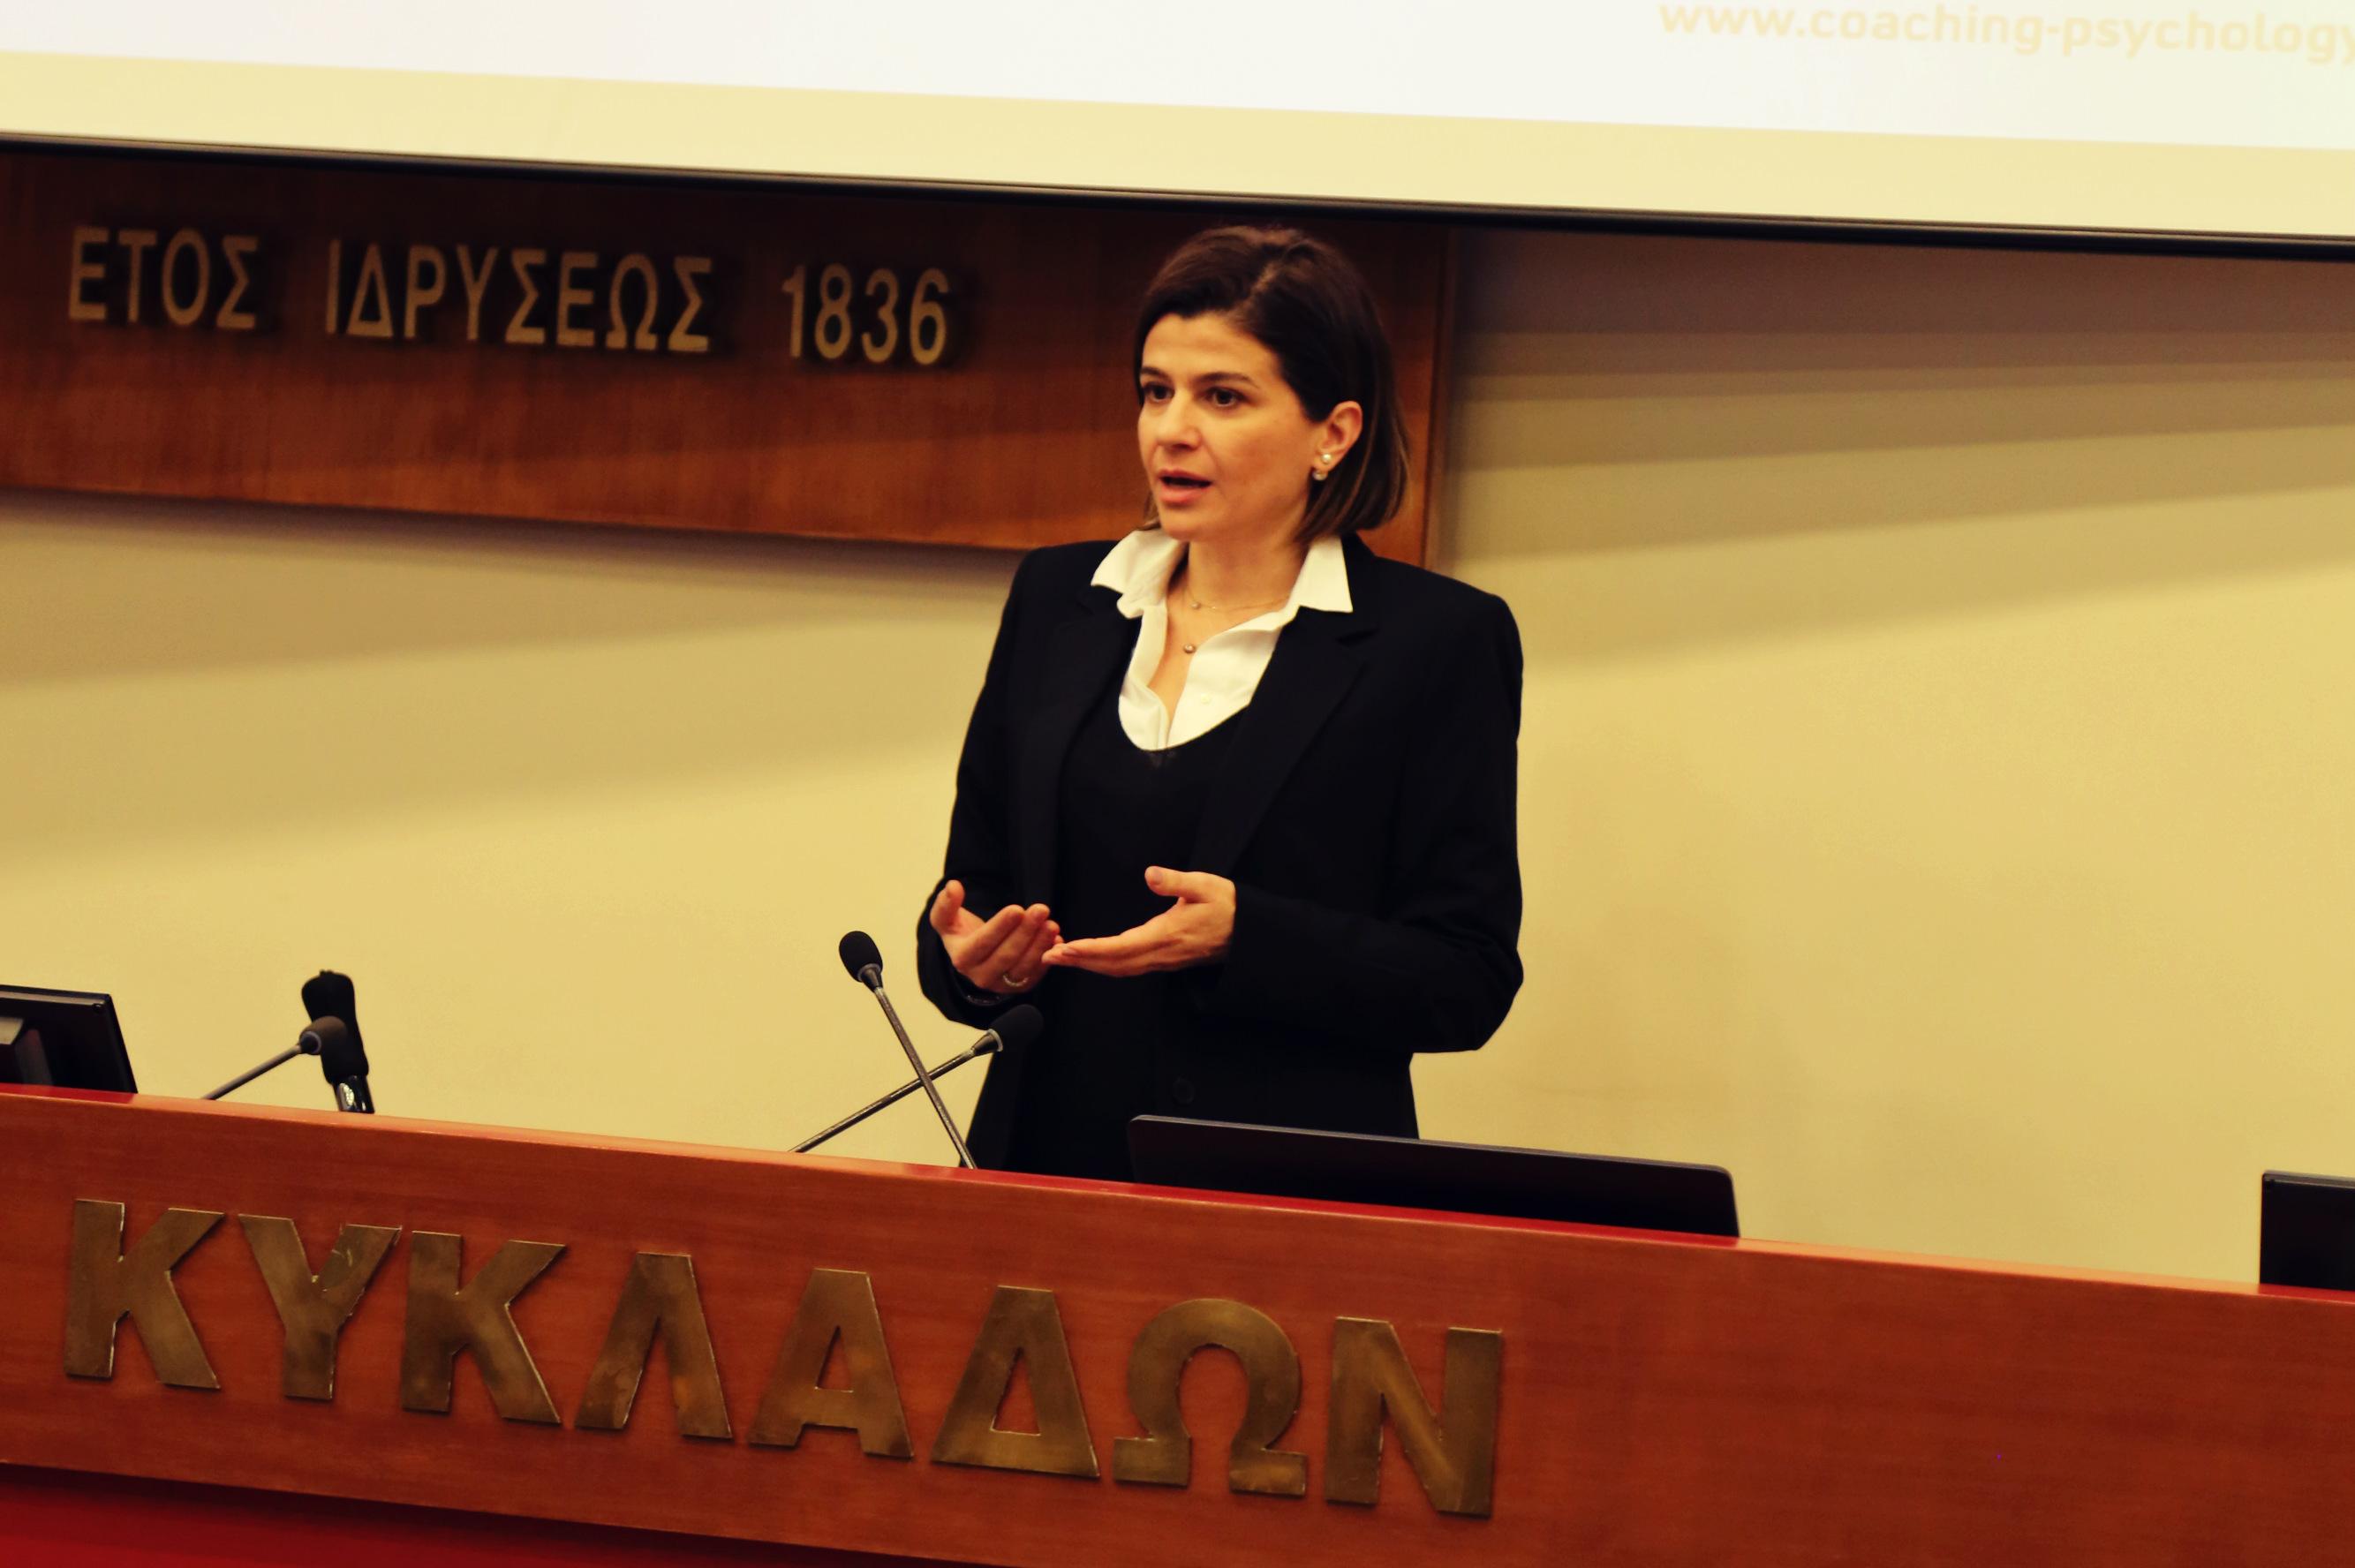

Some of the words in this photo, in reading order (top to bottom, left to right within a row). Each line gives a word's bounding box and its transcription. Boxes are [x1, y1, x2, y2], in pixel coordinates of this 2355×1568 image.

[69, 226, 259, 330] ΕΤΟΣ
[325, 238, 713, 351] ΙΔΡΥΣΕΩΣ
[781, 263, 949, 366] 1836
[65, 1198, 1502, 1516] ΚΥΚΛΑΔΩΝ
